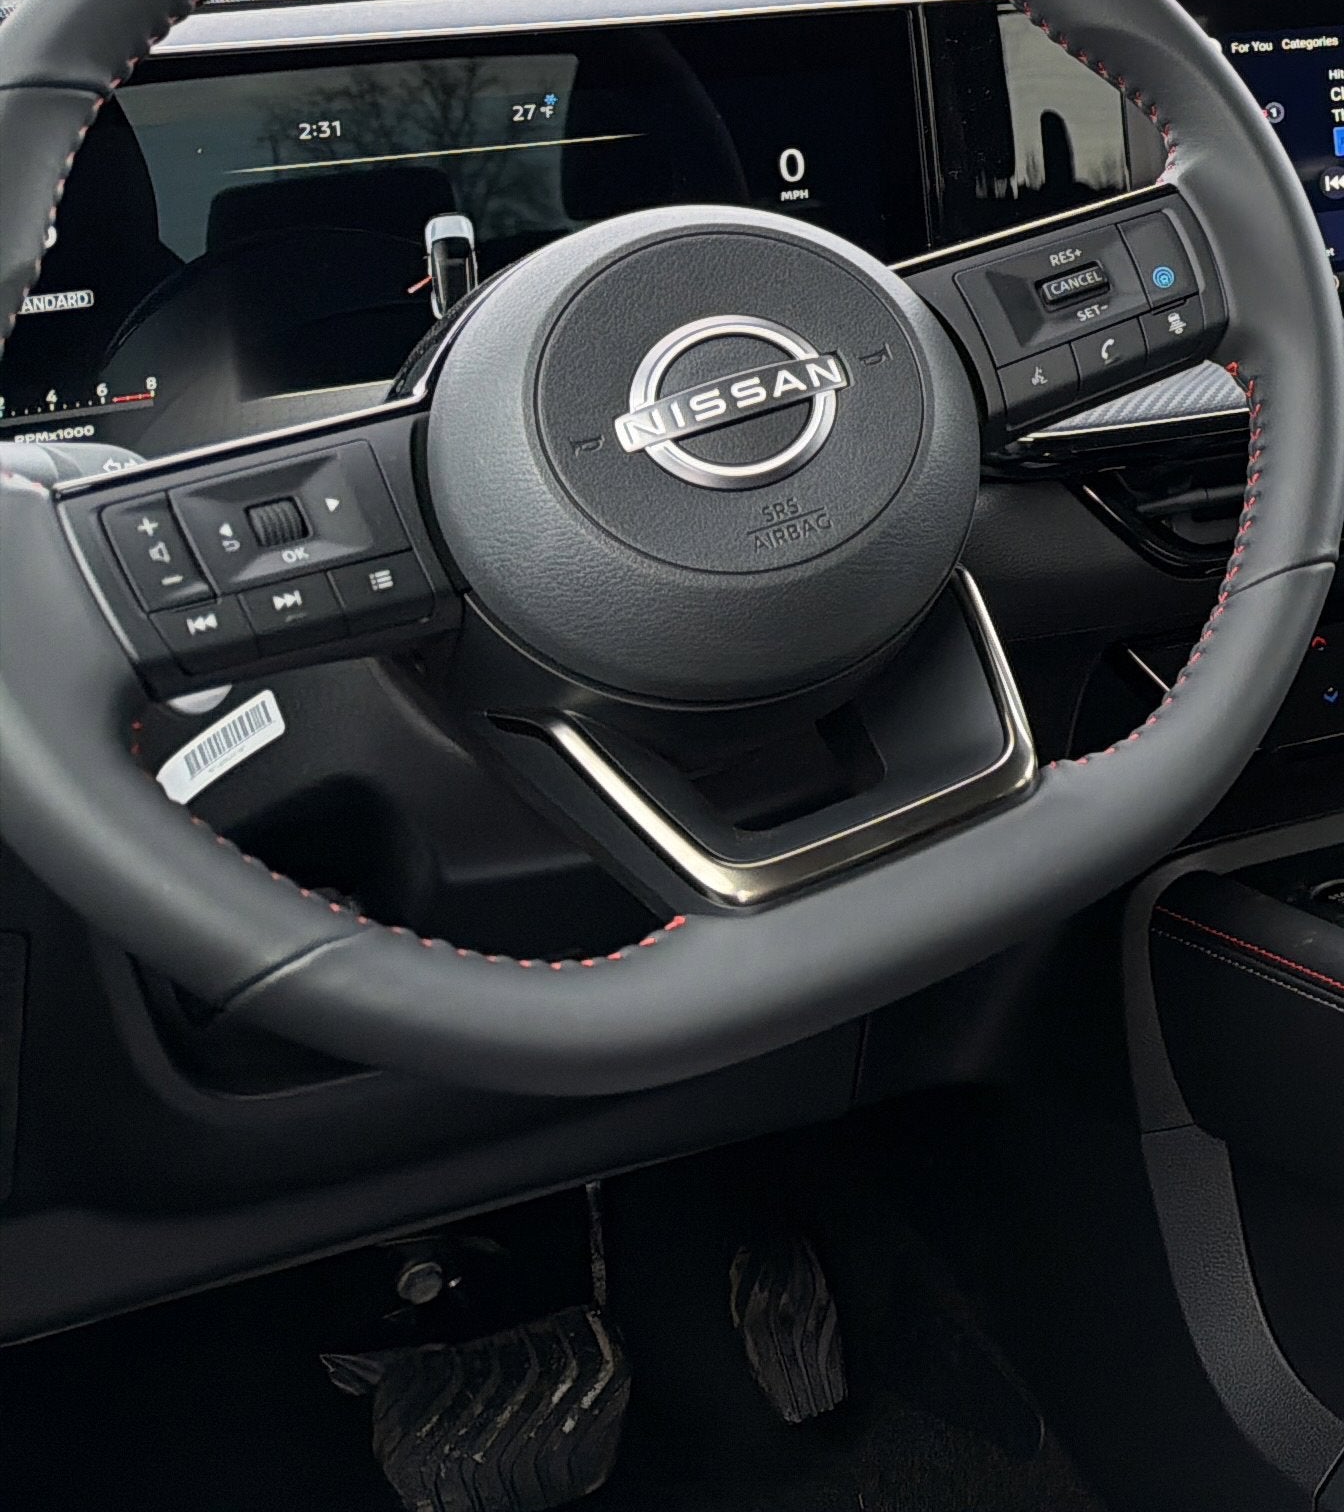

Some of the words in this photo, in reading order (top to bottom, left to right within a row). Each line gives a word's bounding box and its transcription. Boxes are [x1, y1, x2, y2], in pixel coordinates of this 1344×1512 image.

[1231, 42, 1250, 55] For
[1250, 40, 1273, 53] You
[1281, 35, 1339, 52] Categories
[512, 104, 537, 123] 27
[298, 119, 342, 141] 2:31
[778, 148, 806, 182] 0
[779, 188, 810, 202] MPH
[1051, 270, 1104, 296] CANCEL
[21, 292, 89, 313] ANDARD
[46, 389, 58, 403] 4
[96, 383, 108, 397] 6
[145, 375, 158, 390] 8
[626, 356, 844, 446] NISSAN
[760, 497, 800, 524] SRS
[752, 512, 834, 555] AIRBAG
[281, 546, 311, 564] OK
